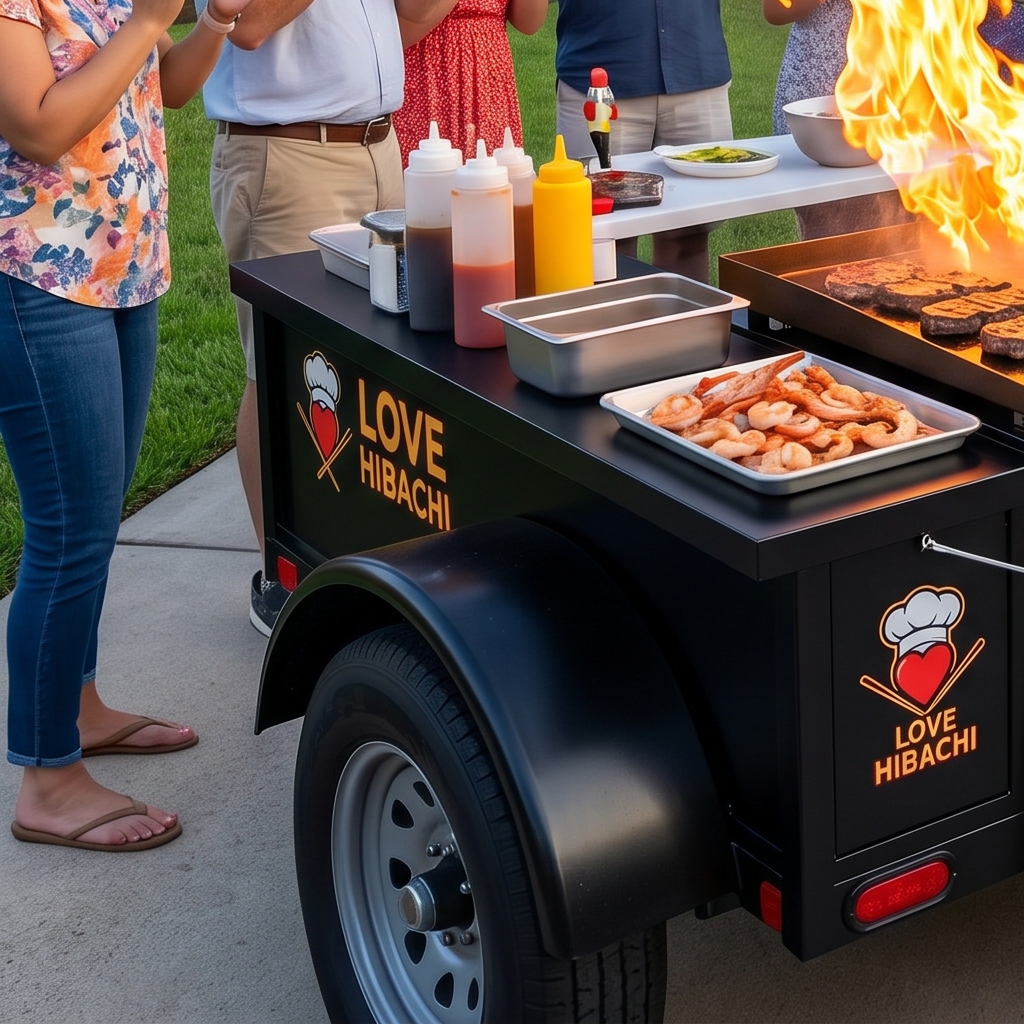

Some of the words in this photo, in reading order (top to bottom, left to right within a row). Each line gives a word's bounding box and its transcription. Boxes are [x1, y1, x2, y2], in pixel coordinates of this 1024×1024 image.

[357, 378, 447, 483] LOVE
[359, 444, 451, 532] HIBACHI
[874, 725, 978, 786] HIBACHI
[895, 707, 957, 751] LOVE
